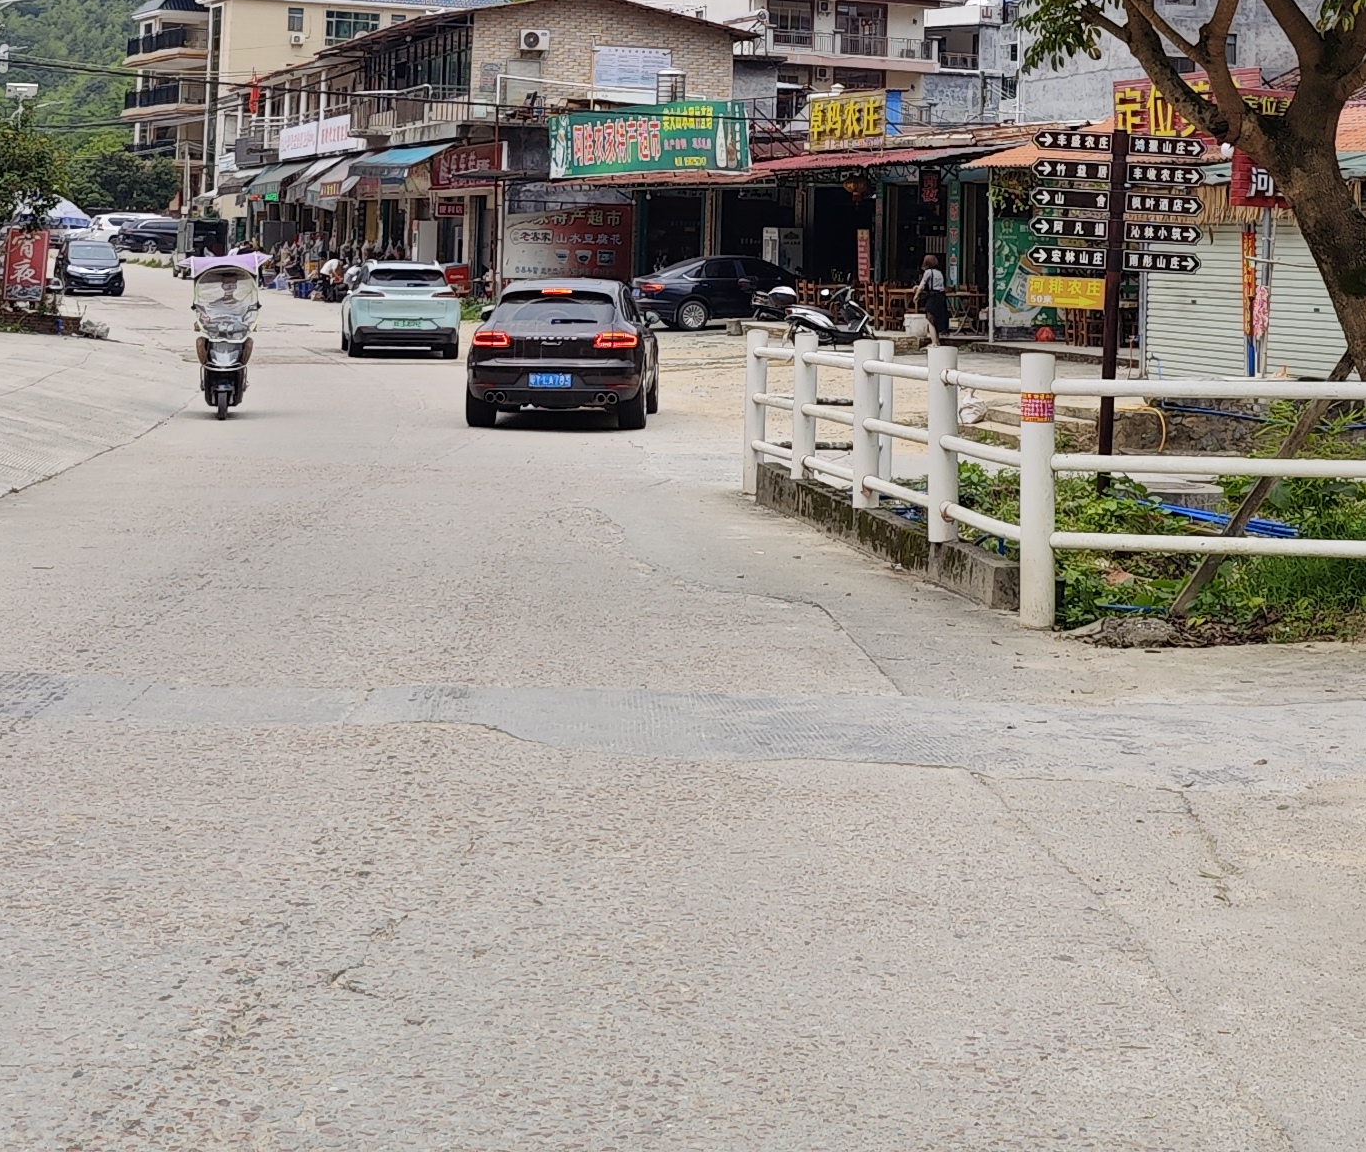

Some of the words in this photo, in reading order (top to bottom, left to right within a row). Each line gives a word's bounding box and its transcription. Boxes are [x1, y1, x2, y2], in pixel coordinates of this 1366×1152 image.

[1132, 167, 1185, 183] 丰收农庄
[1131, 196, 1184, 212] 枫叶酒店
[556, 232, 623, 246] 山水豆腐花
[10, 233, 41, 284] 宵夜
[1029, 277, 1102, 297] 河排农庄
